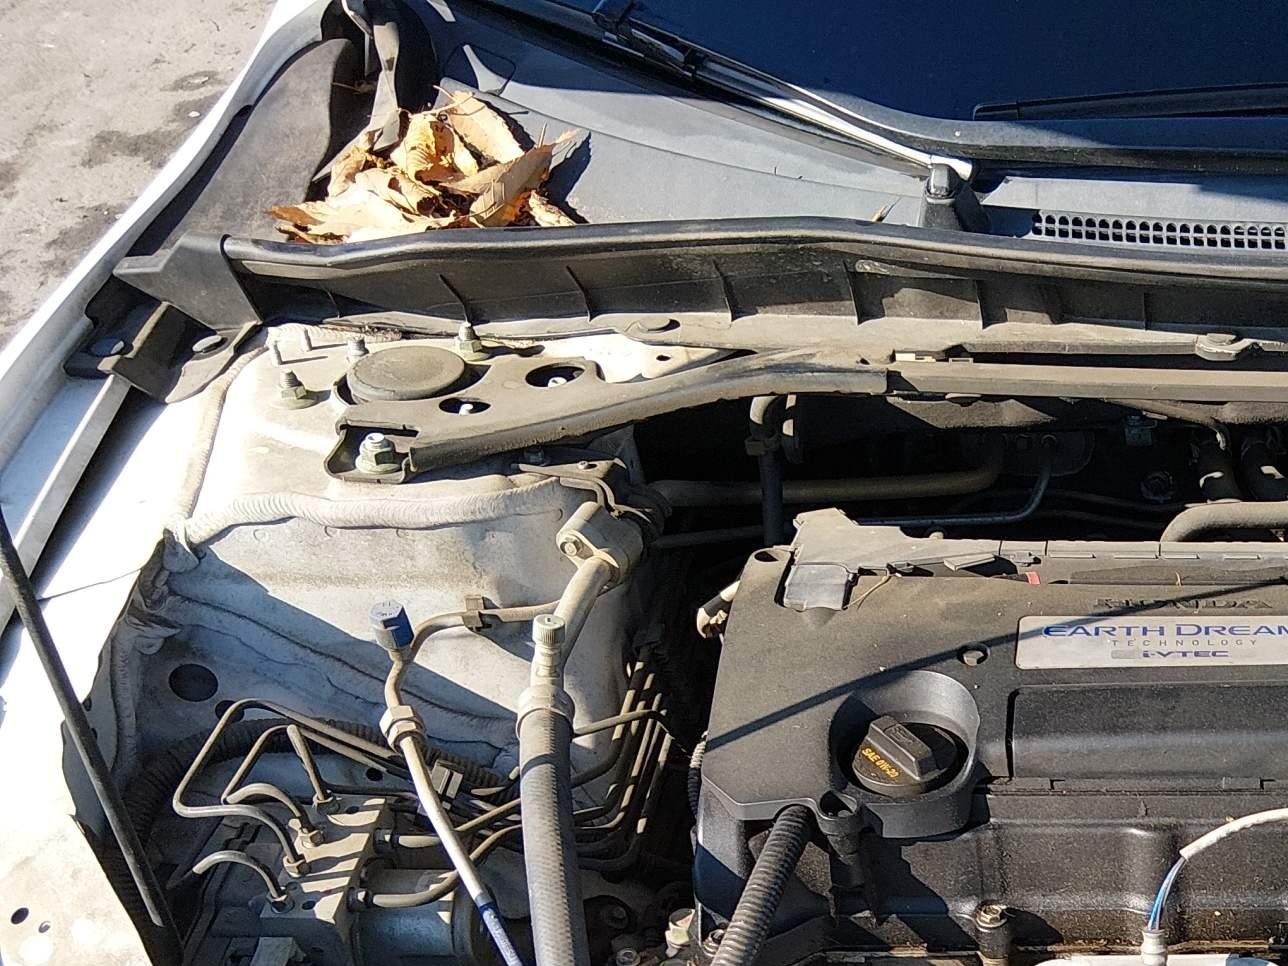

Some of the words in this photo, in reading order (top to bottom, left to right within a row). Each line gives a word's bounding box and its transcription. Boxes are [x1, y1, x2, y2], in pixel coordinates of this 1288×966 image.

[1043, 623, 1165, 637] EARTH
[1111, 639, 1258, 647] TECHNOLOGY
[1142, 650, 1230, 658] i-VTEC
[862, 748, 880, 762] SAE
